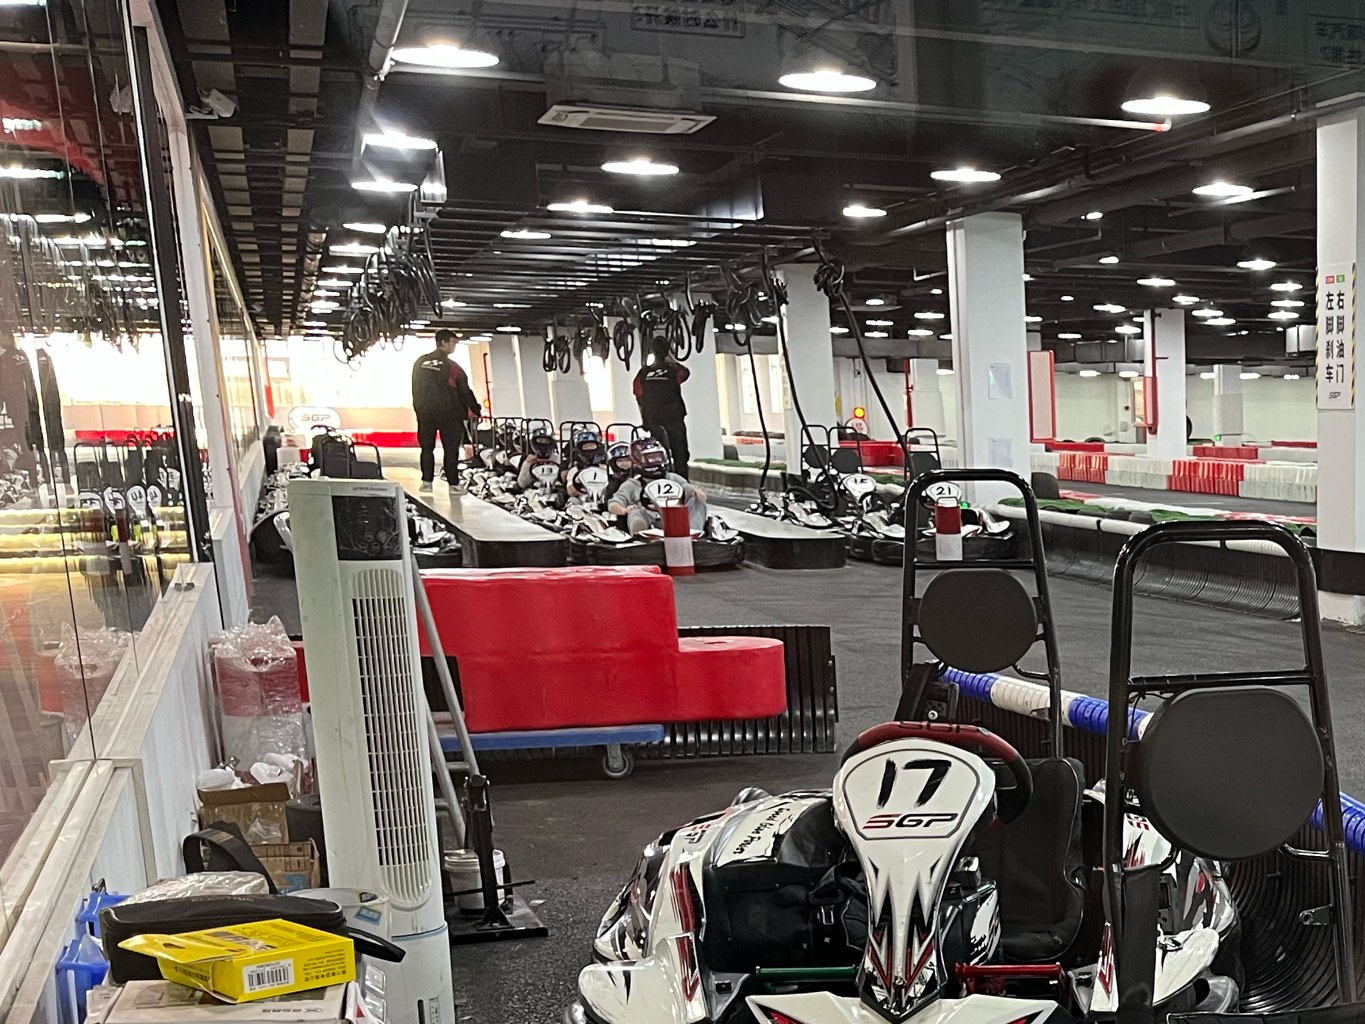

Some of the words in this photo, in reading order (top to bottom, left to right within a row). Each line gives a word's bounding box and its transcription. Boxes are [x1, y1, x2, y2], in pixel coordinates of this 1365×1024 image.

[1325, 291, 1334, 383] 左脚刹车
[1336, 289, 1345, 383] 右脚油门
[657, 483, 675, 495] 12
[936, 486, 952, 496] 21
[876, 756, 952, 810] 17
[861, 812, 959, 830] SGP
